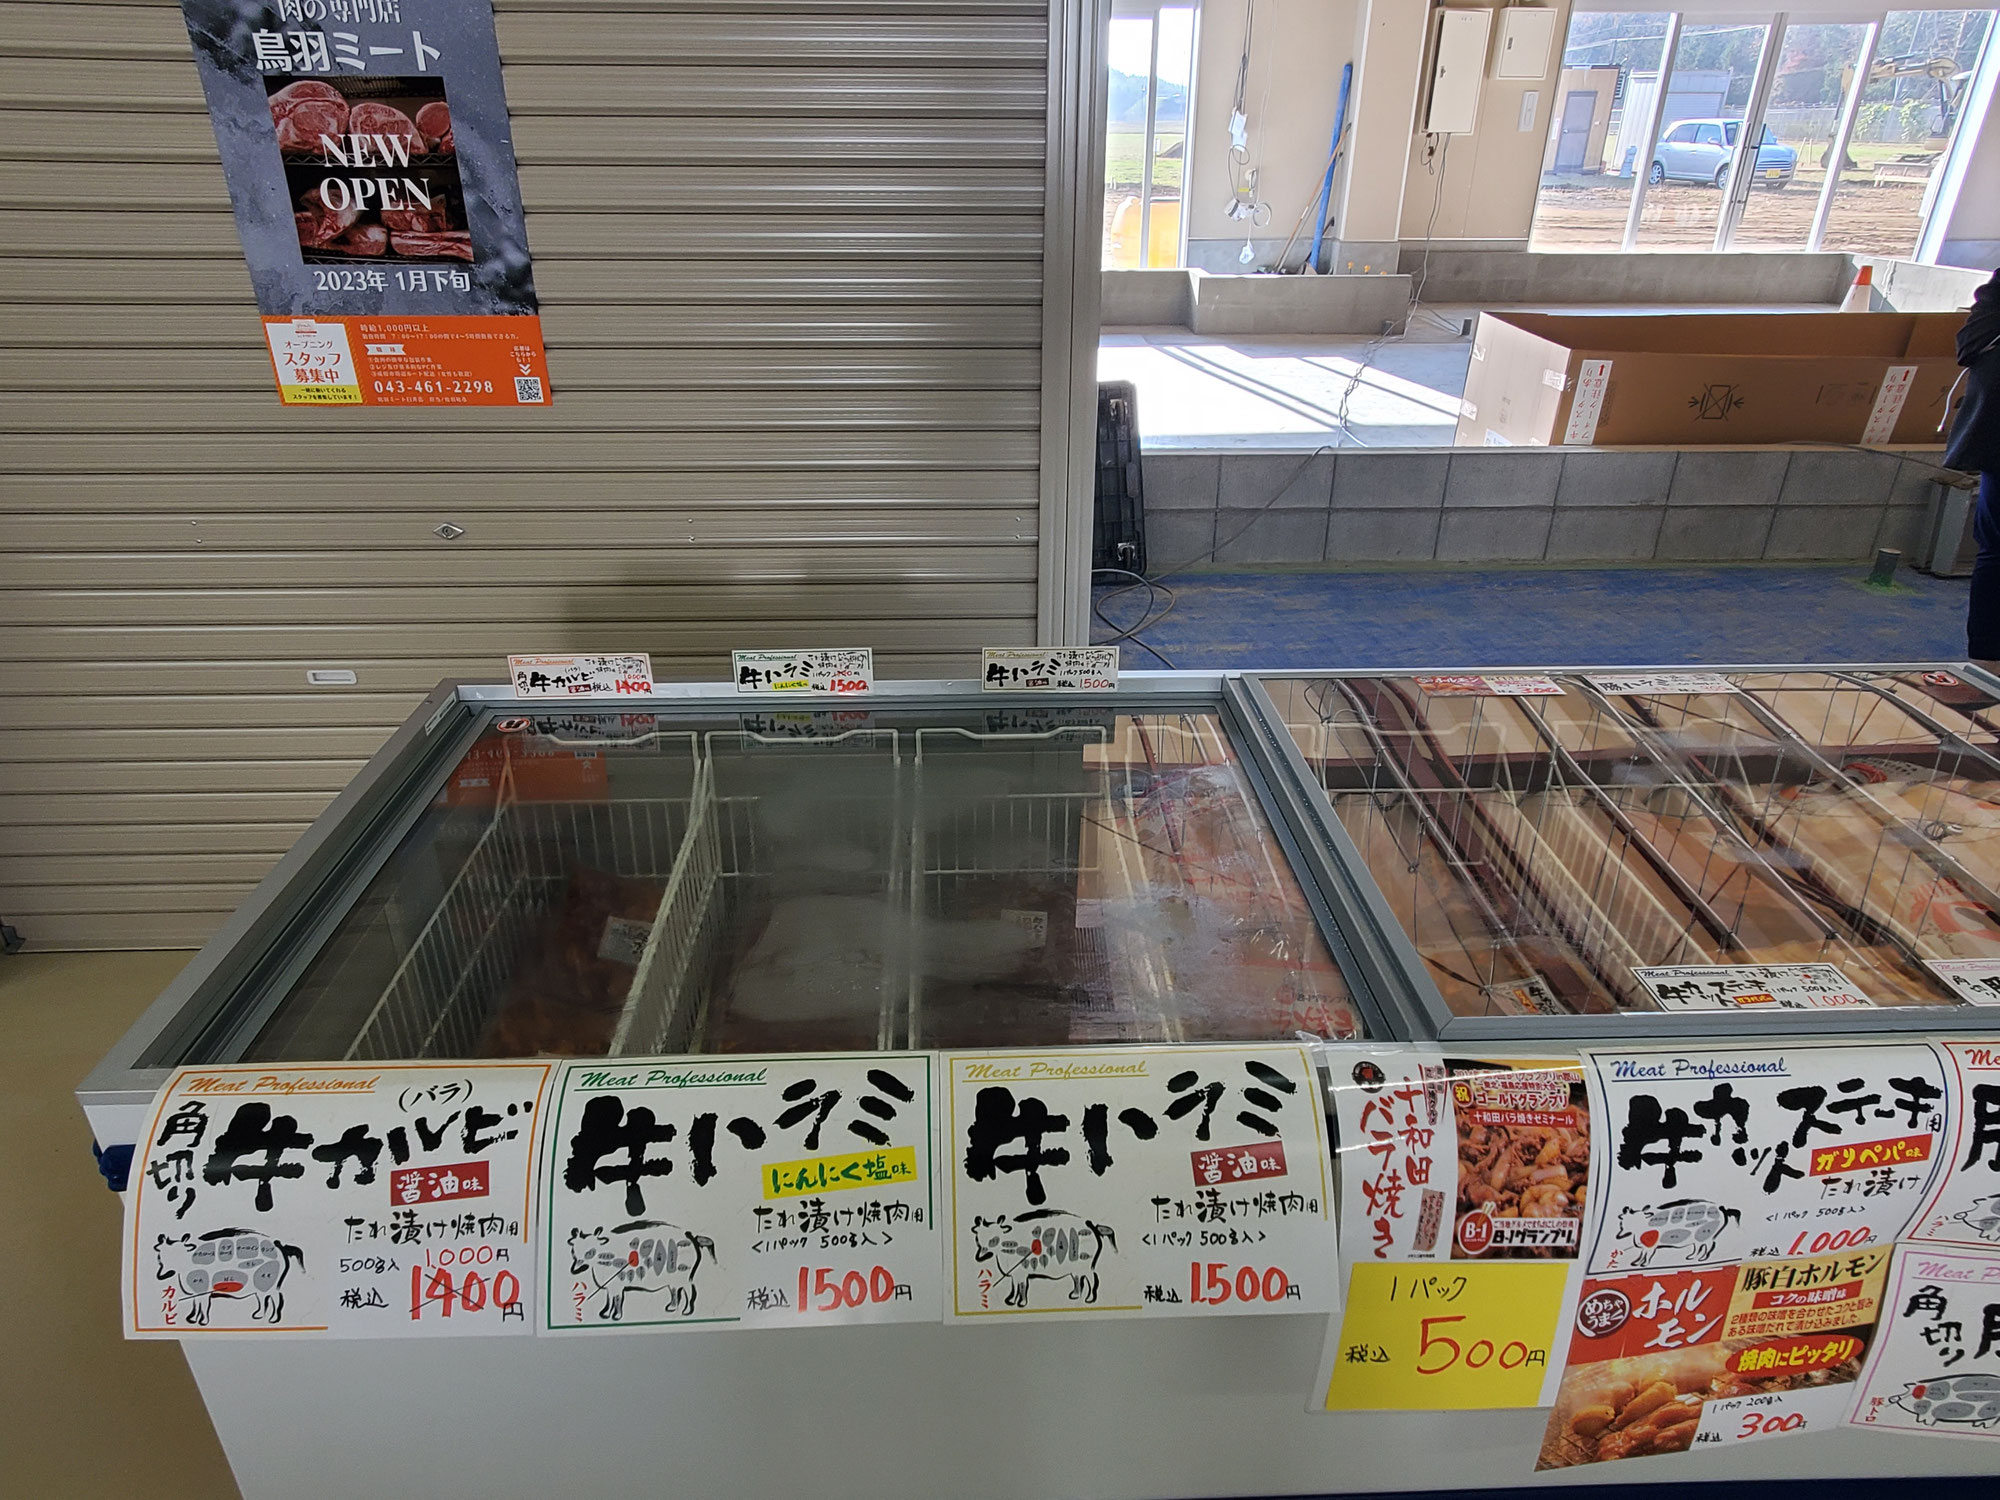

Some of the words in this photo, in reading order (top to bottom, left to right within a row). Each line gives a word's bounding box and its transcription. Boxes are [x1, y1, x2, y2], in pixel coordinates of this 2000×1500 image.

[278, 0, 401, 23] 肉の専門店
[252, 28, 441, 72] 鳥羽ミート
[318, 133, 412, 168] NEW
[319, 177, 432, 211] OPEN
[316, 270, 389, 292] 2023年
[399, 270, 471, 292] 1月下旬
[283, 352, 341, 366] スタッフ
[285, 341, 334, 349] オープニング
[293, 368, 339, 383] 募集中
[374, 380, 493, 393] 043-461-2298
[530, 671, 595, 692] 牛カルビ
[740, 661, 814, 689] 牛ハラミ
[986, 658, 1061, 687] 牛ハラミ
[581, 1071, 638, 1087] Meat
[645, 1068, 767, 1089] Professional
[965, 1063, 1021, 1078] Meat
[1029, 1060, 1147, 1080] Professional
[1611, 1059, 1667, 1077] Meat
[1673, 1057, 1788, 1078] Professional
[190, 1077, 246, 1093] Meat
[253, 1075, 382, 1096] Professional
[398, 1079, 473, 1112] (バラ)
[1455, 1085, 1470, 1102] 祝
[1477, 1092, 1568, 1108] ゴールドグランプリ
[964, 1060, 1296, 1206] 牛ハラミ
[1394, 1076, 1435, 1186] 十和田
[1473, 1112, 1574, 1125] 十和田バラ焼きゼミナール
[203, 1101, 533, 1212] 牛カルビ
[563, 1069, 915, 1217] 牛ハラミ
[1817, 1143, 1923, 1171] ガリペパ味
[146, 1101, 209, 1219] 角切り
[772, 1153, 911, 1194] にんにく塩味
[1198, 1150, 1281, 1184] 醤油味
[396, 1172, 483, 1204] 醤油味
[1360, 1094, 1405, 1259] バラ焼き
[1821, 1168, 1921, 1199] たれ漬け
[753, 1198, 924, 1234] たれ漬け焼肉用
[1151, 1188, 1318, 1223] たれ漬け焼肉用
[344, 1209, 518, 1245] たれ漬け焼肉用
[1465, 1222, 1488, 1238] B-1
[1749, 1246, 1780, 1257] 税込
[1742, 1252, 1886, 1292] 豚白ホルモン
[1918, 1261, 1974, 1280] Meat
[340, 1287, 389, 1309] 税込
[572, 1281, 587, 1323] ハラミ
[747, 1286, 790, 1311] 税込
[798, 1265, 912, 1313] 1500円
[978, 1269, 992, 1309] ハラミ
[1144, 1285, 1182, 1303] 税込
[1632, 1279, 1713, 1319] ホル
[1770, 1287, 1847, 1306] コクの味噌味
[161, 1285, 178, 1325] カルビ
[1585, 1299, 1624, 1315] めちゃ
[1643, 1313, 1723, 1348] モン
[1903, 1285, 1965, 1367] 角切り
[1344, 1343, 1391, 1363] 税込
[1416, 1315, 1545, 1374] 500円
[1737, 1338, 1854, 1372] 焼肉にピッタリ
[1865, 1396, 1885, 1422] 豚トロ
[1695, 1431, 1723, 1443] 税込
